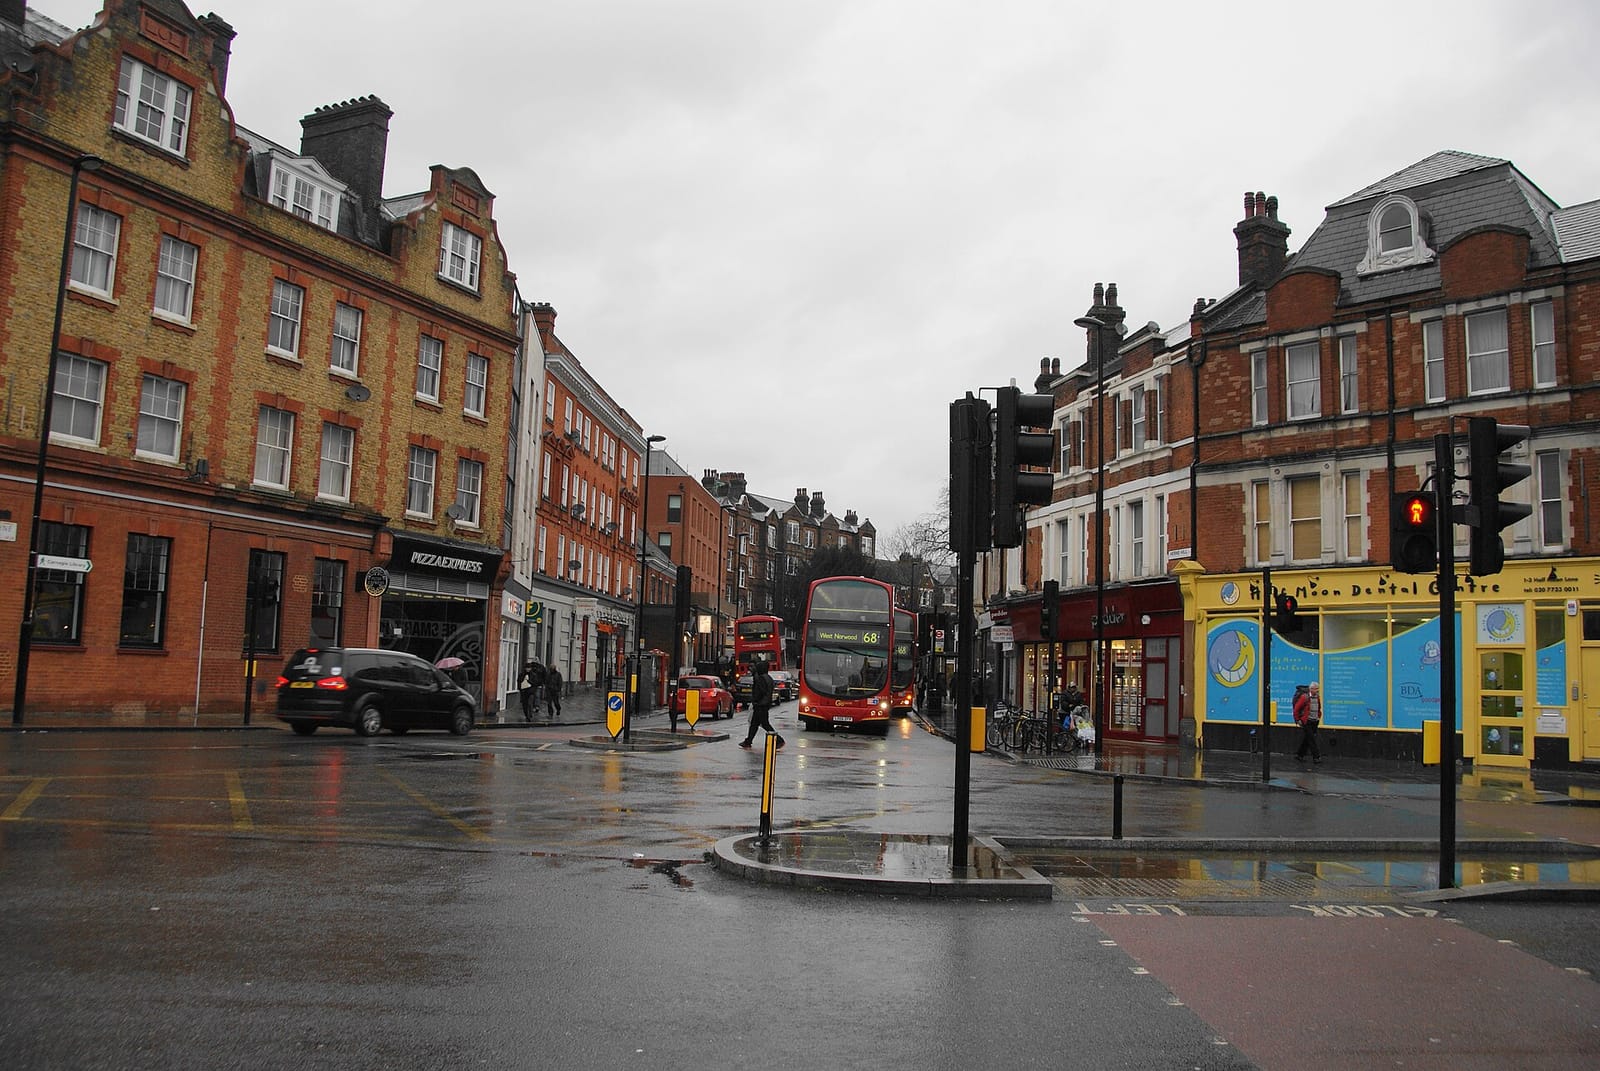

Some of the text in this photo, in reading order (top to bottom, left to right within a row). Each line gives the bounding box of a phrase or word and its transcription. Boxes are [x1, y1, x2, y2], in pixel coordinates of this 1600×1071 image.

[411, 551, 484, 573] PIZZAEXPRESS
[1296, 586, 1341, 599] Moon
[1351, 580, 1417, 597] Dental
[1429, 582, 1499, 596] Cntre
[863, 632, 877, 643] 68
[1401, 685, 1421, 695] BDA
